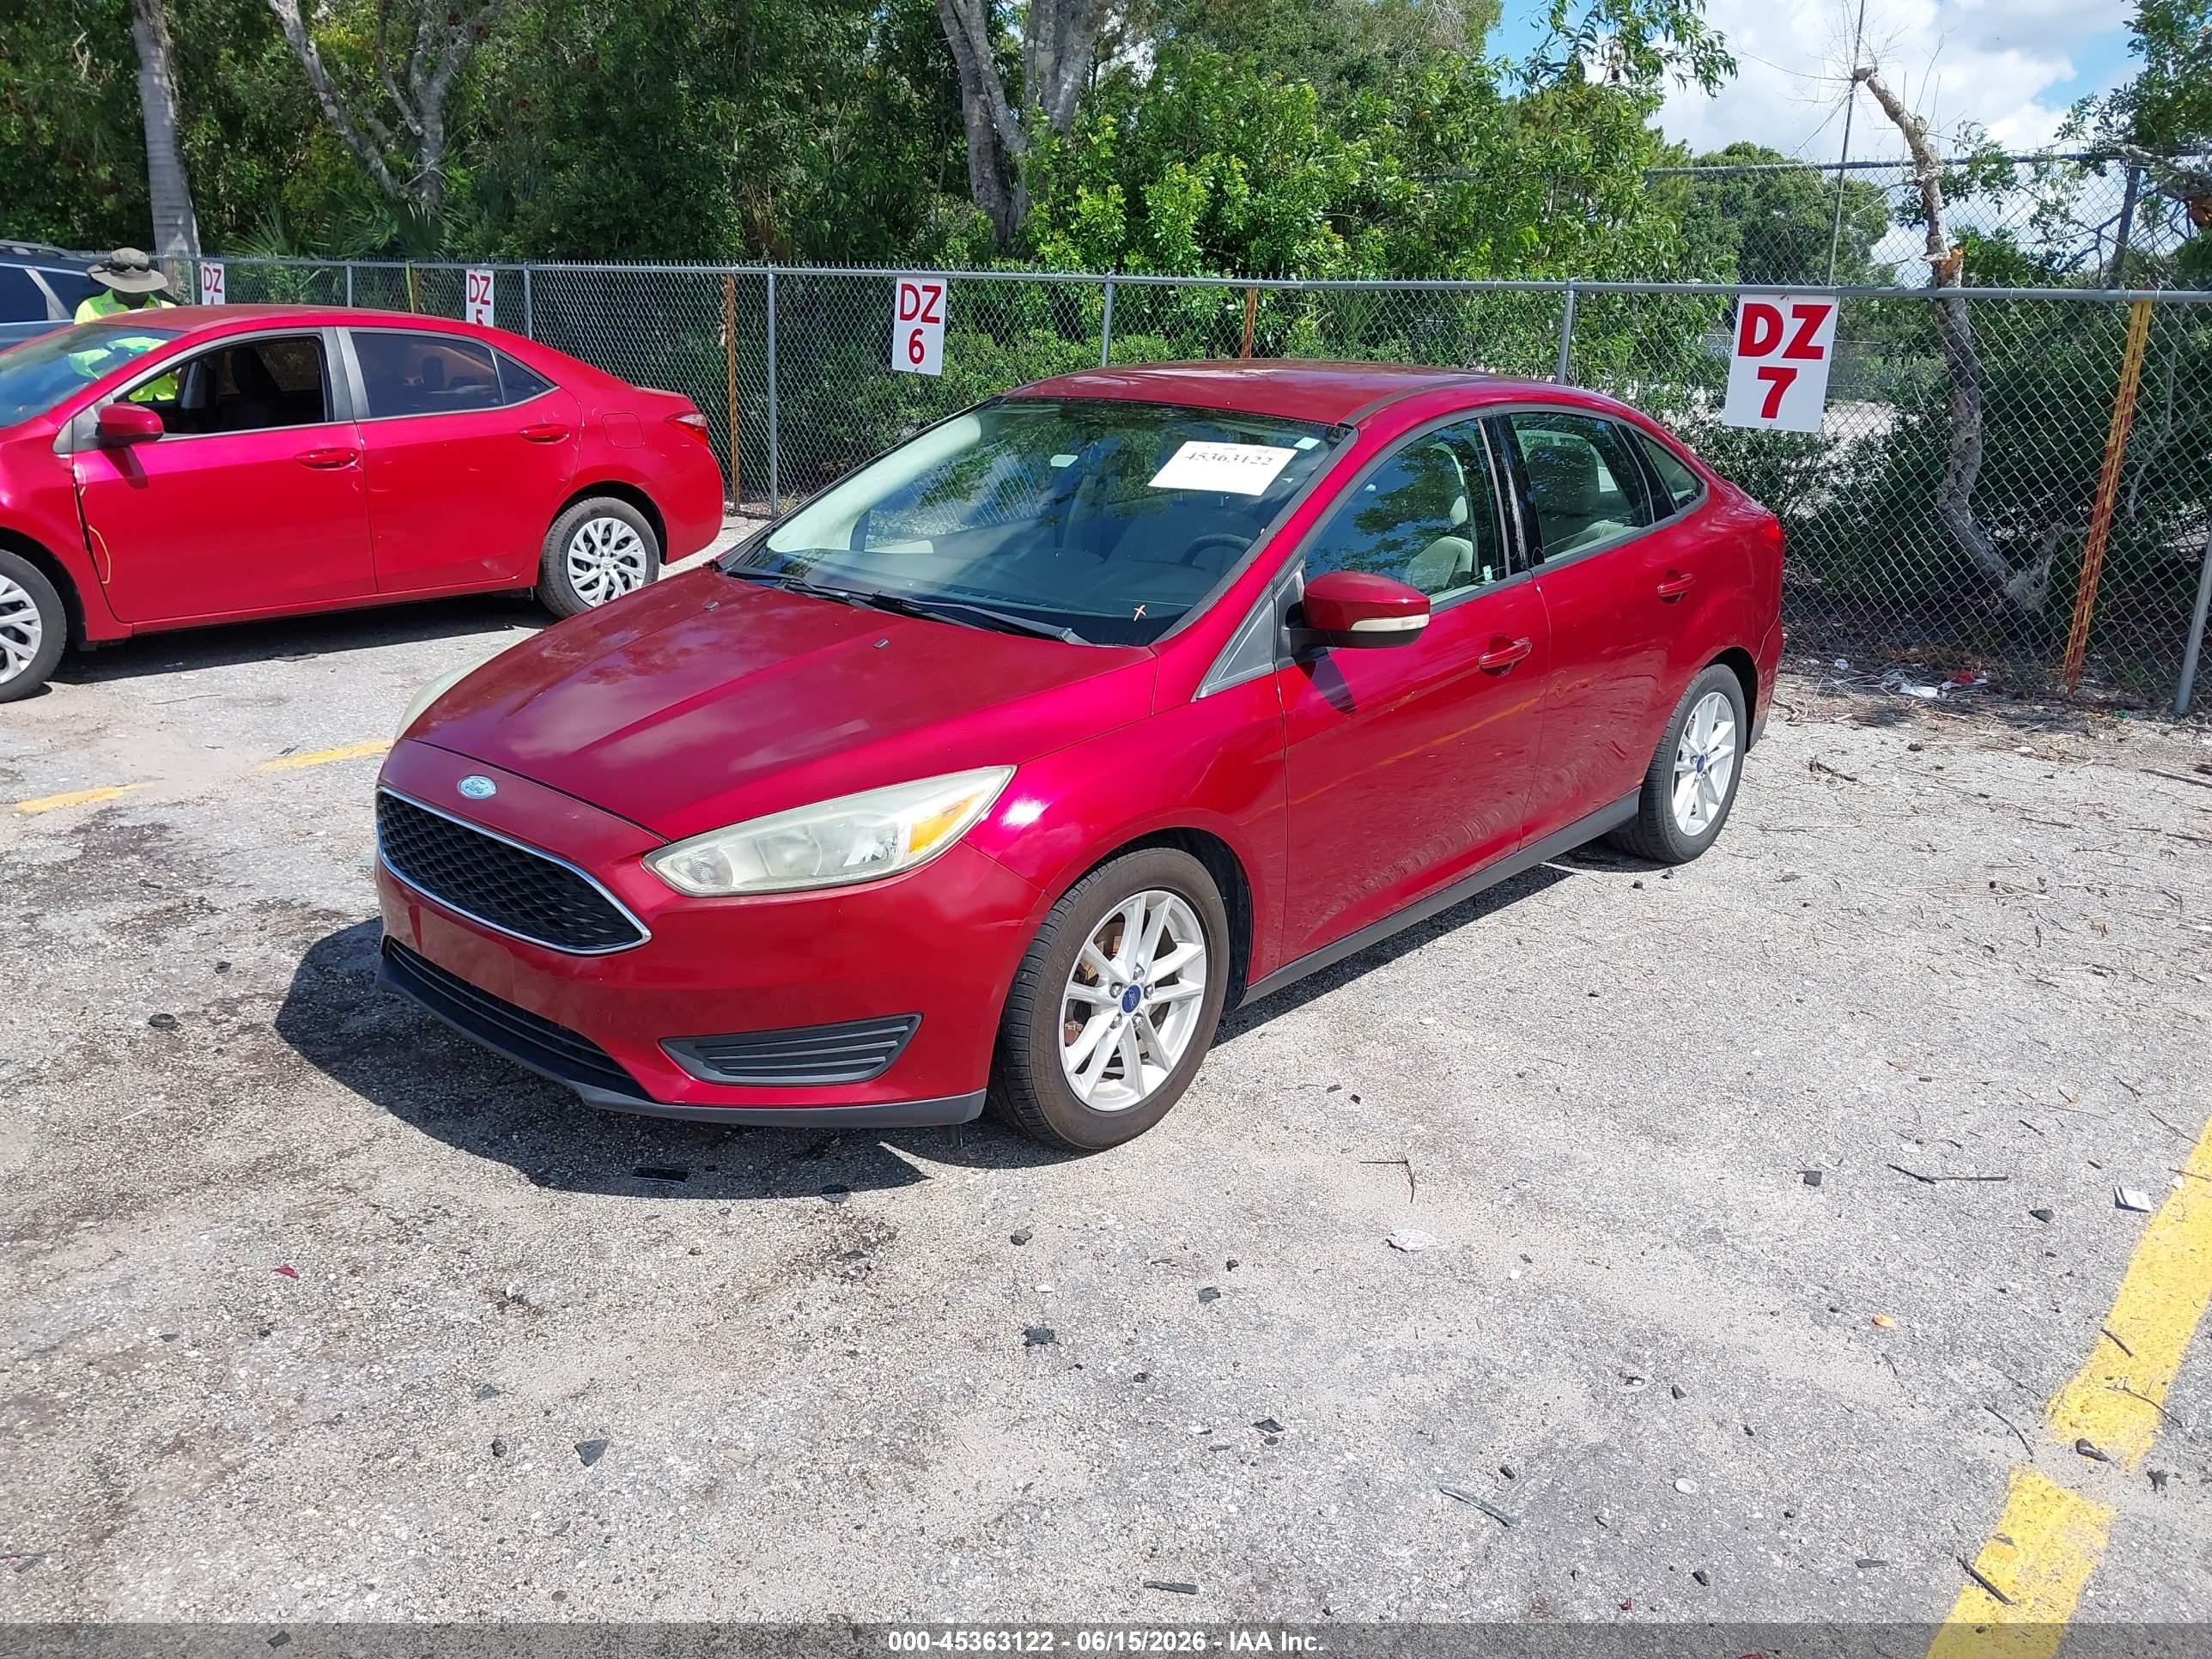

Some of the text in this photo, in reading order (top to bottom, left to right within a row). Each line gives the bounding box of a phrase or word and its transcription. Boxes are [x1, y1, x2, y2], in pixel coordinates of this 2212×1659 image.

[203, 264, 223, 294] DZ
[468, 273, 491, 306] DZ
[899, 283, 942, 324] DZ
[908, 328, 925, 364] 6
[1738, 302, 1833, 360] DZ
[1757, 366, 1798, 419] 7
